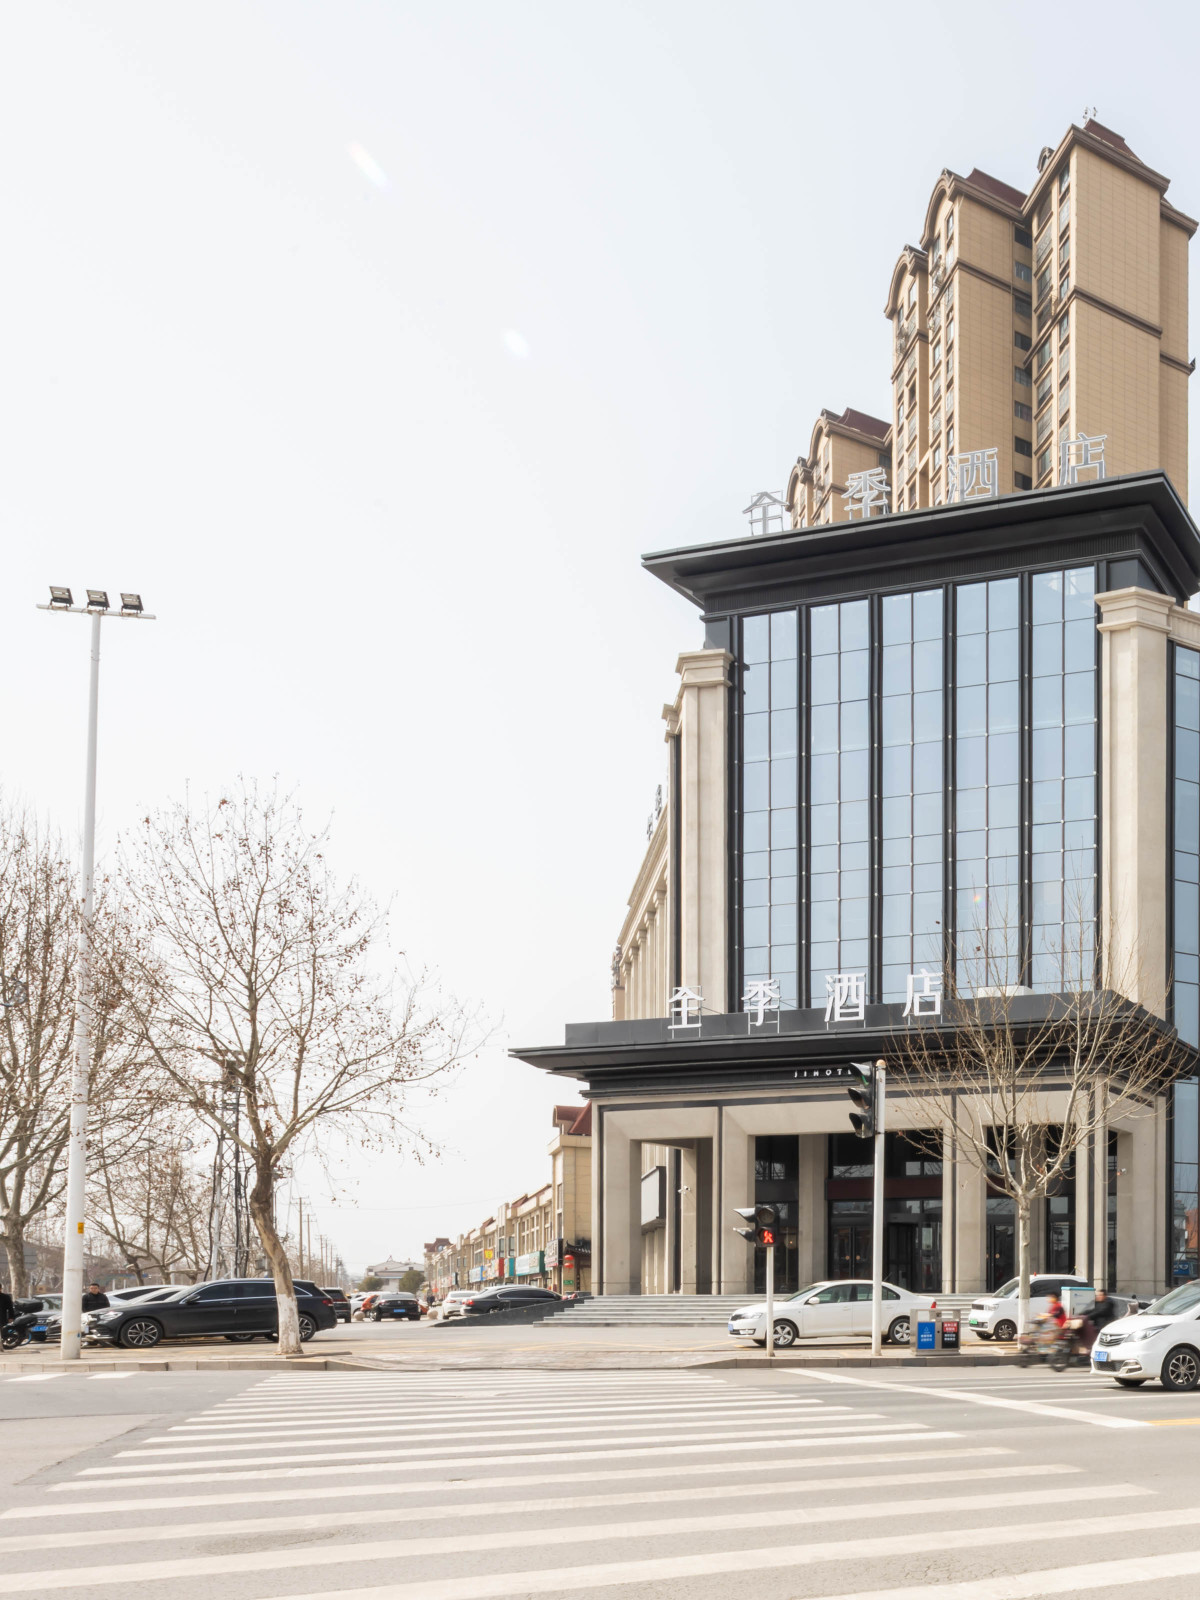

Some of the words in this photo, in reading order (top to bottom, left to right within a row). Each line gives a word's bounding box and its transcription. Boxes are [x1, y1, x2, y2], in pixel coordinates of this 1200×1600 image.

[742, 433, 1107, 535] 全季酒店
[668, 968, 943, 1029] 全季酒店
